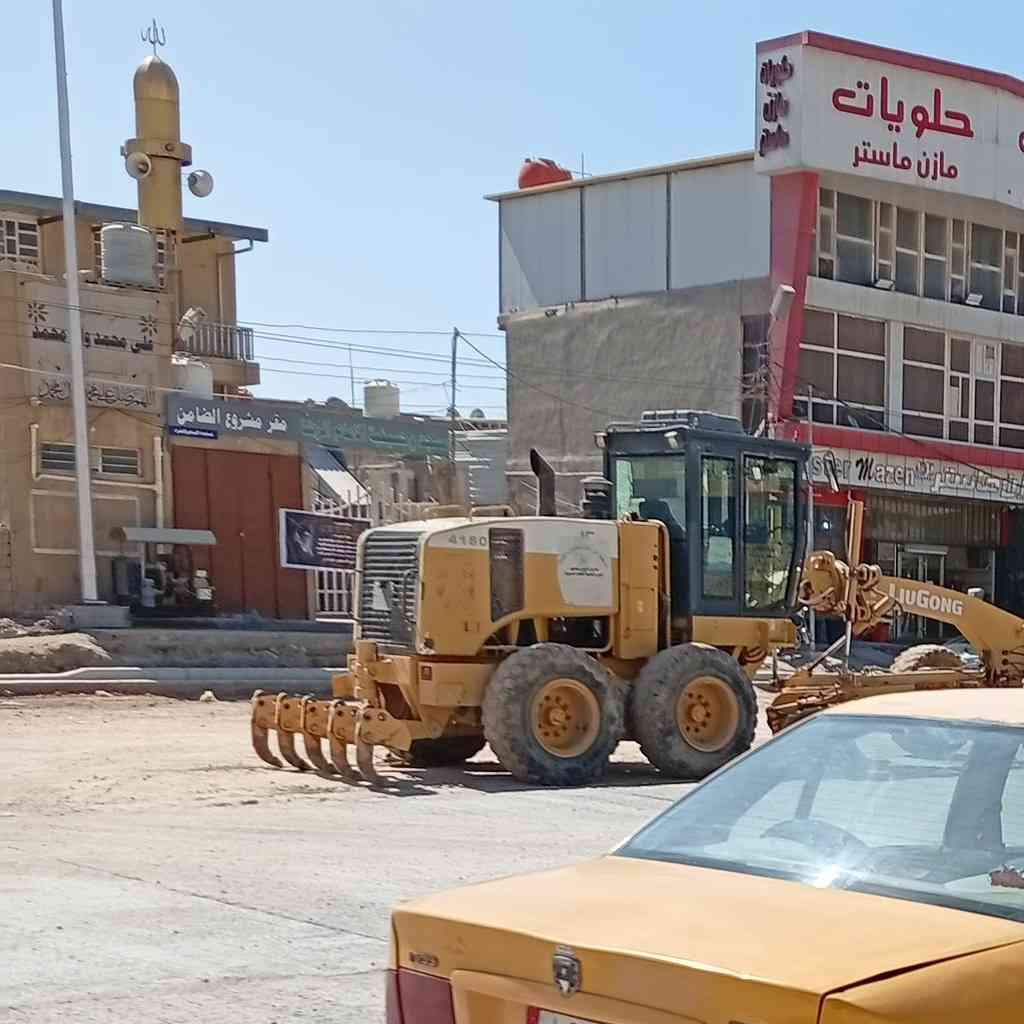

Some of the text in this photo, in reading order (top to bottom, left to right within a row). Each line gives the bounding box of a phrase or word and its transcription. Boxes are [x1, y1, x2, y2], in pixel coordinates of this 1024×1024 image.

[832, 76, 974, 138] حلويات
[852, 141, 958, 181] مازن ماستر
[177, 406, 220, 425] الضامن
[225, 411, 262, 431] مشروع
[856, 458, 915, 486] Mazen
